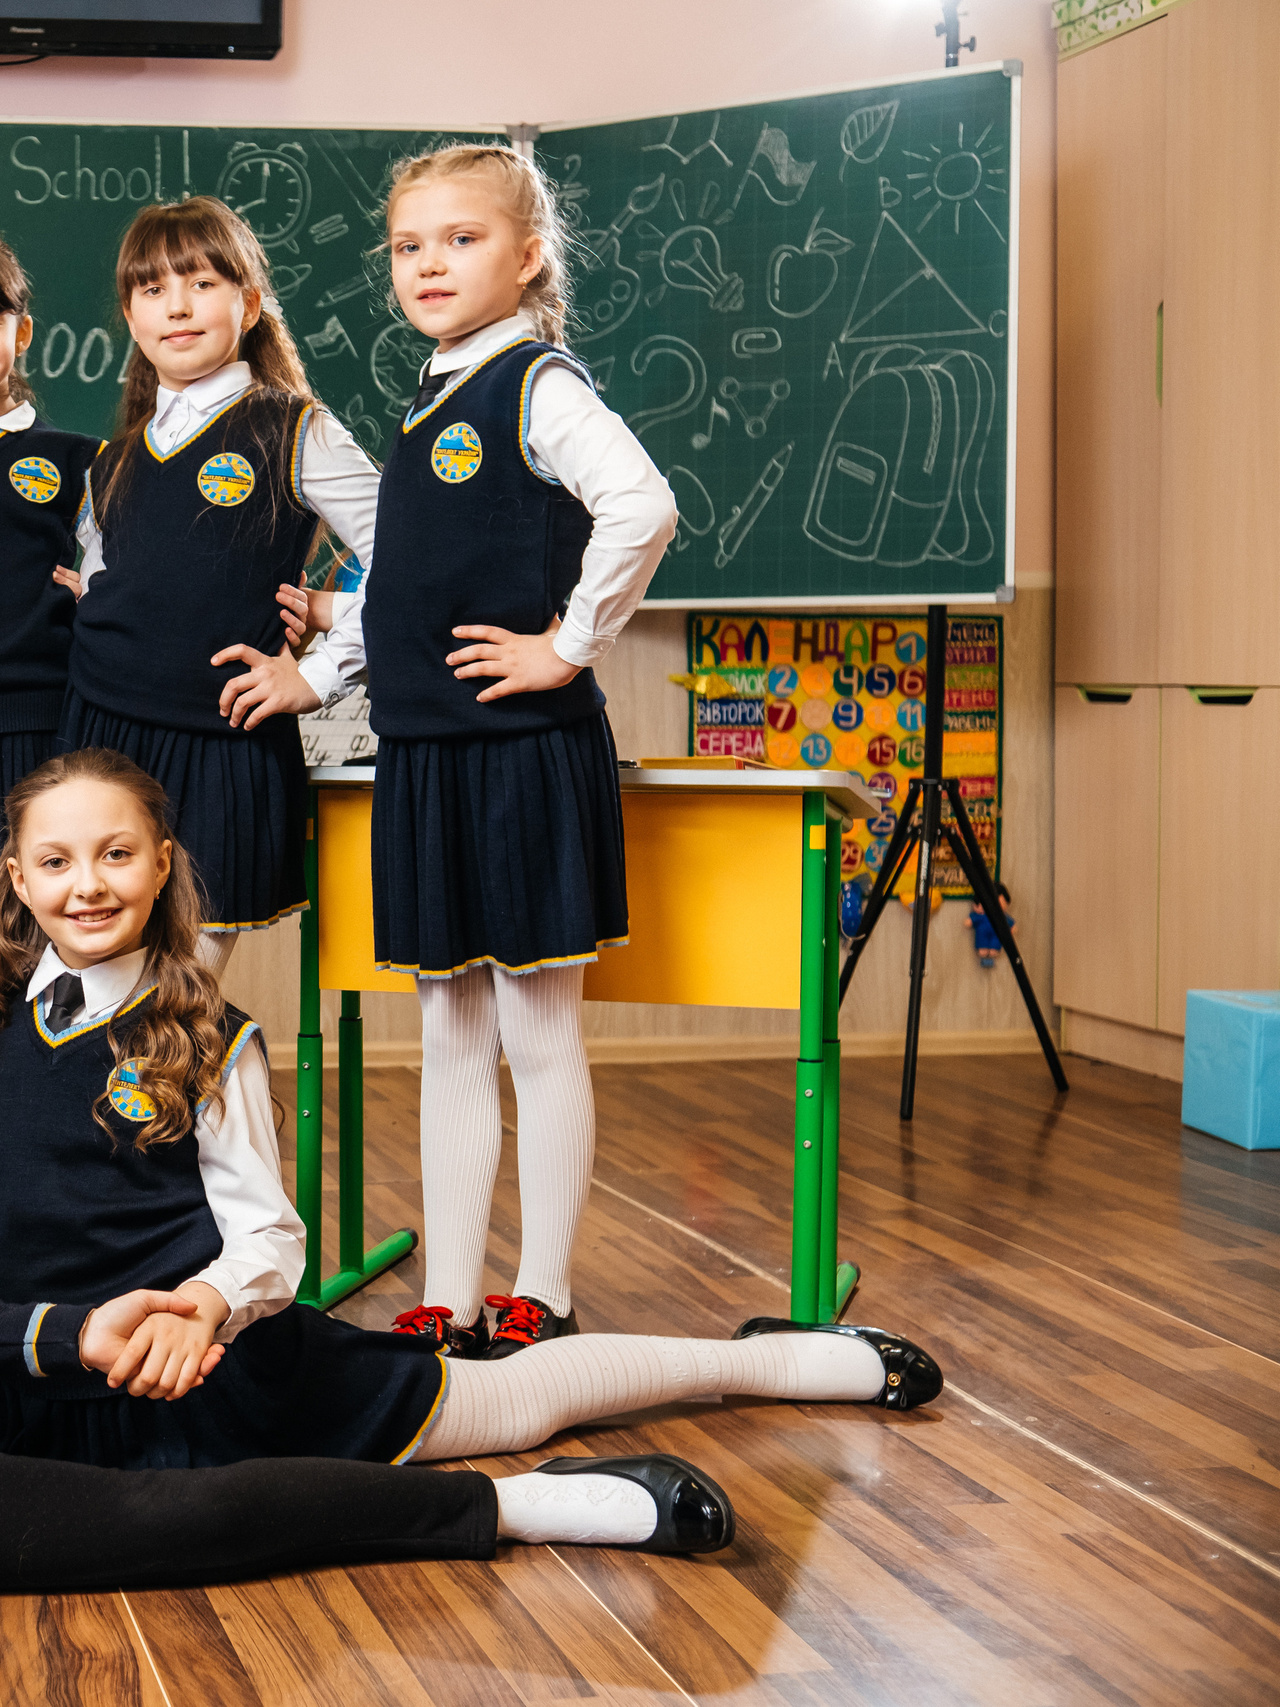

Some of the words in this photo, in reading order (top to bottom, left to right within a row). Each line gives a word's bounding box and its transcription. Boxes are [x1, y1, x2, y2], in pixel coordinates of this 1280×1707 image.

[10, 130, 190, 204] School!
[878, 176, 903, 208] B
[695, 618, 898, 665] КАЛЕНДАР
[698, 731, 765, 756] СЕРЕДА
